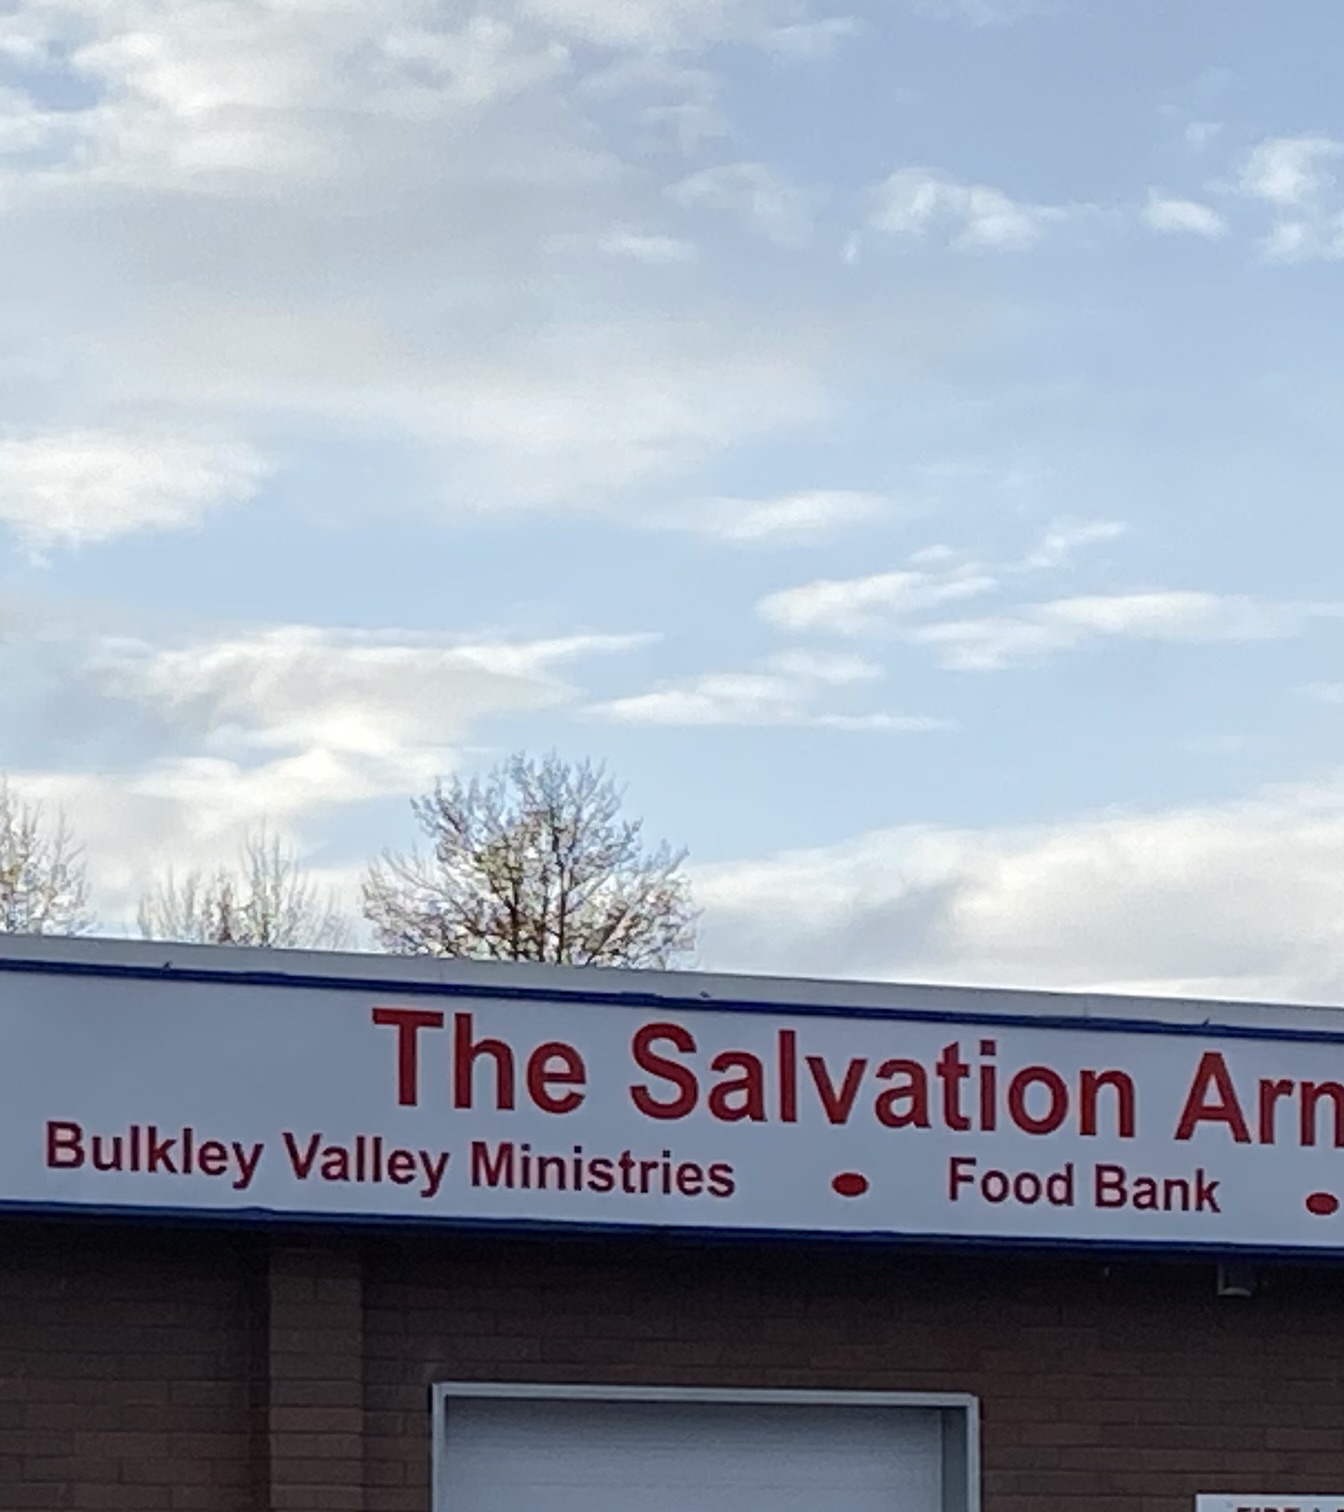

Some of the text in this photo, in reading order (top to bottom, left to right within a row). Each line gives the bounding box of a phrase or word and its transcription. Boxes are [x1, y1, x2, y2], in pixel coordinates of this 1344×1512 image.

[372, 1006, 588, 1115] The
[629, 1022, 1136, 1140] Salvation
[47, 1121, 737, 1200] Bulkley Valley Ministries
[949, 1157, 1223, 1215] Food Bank
